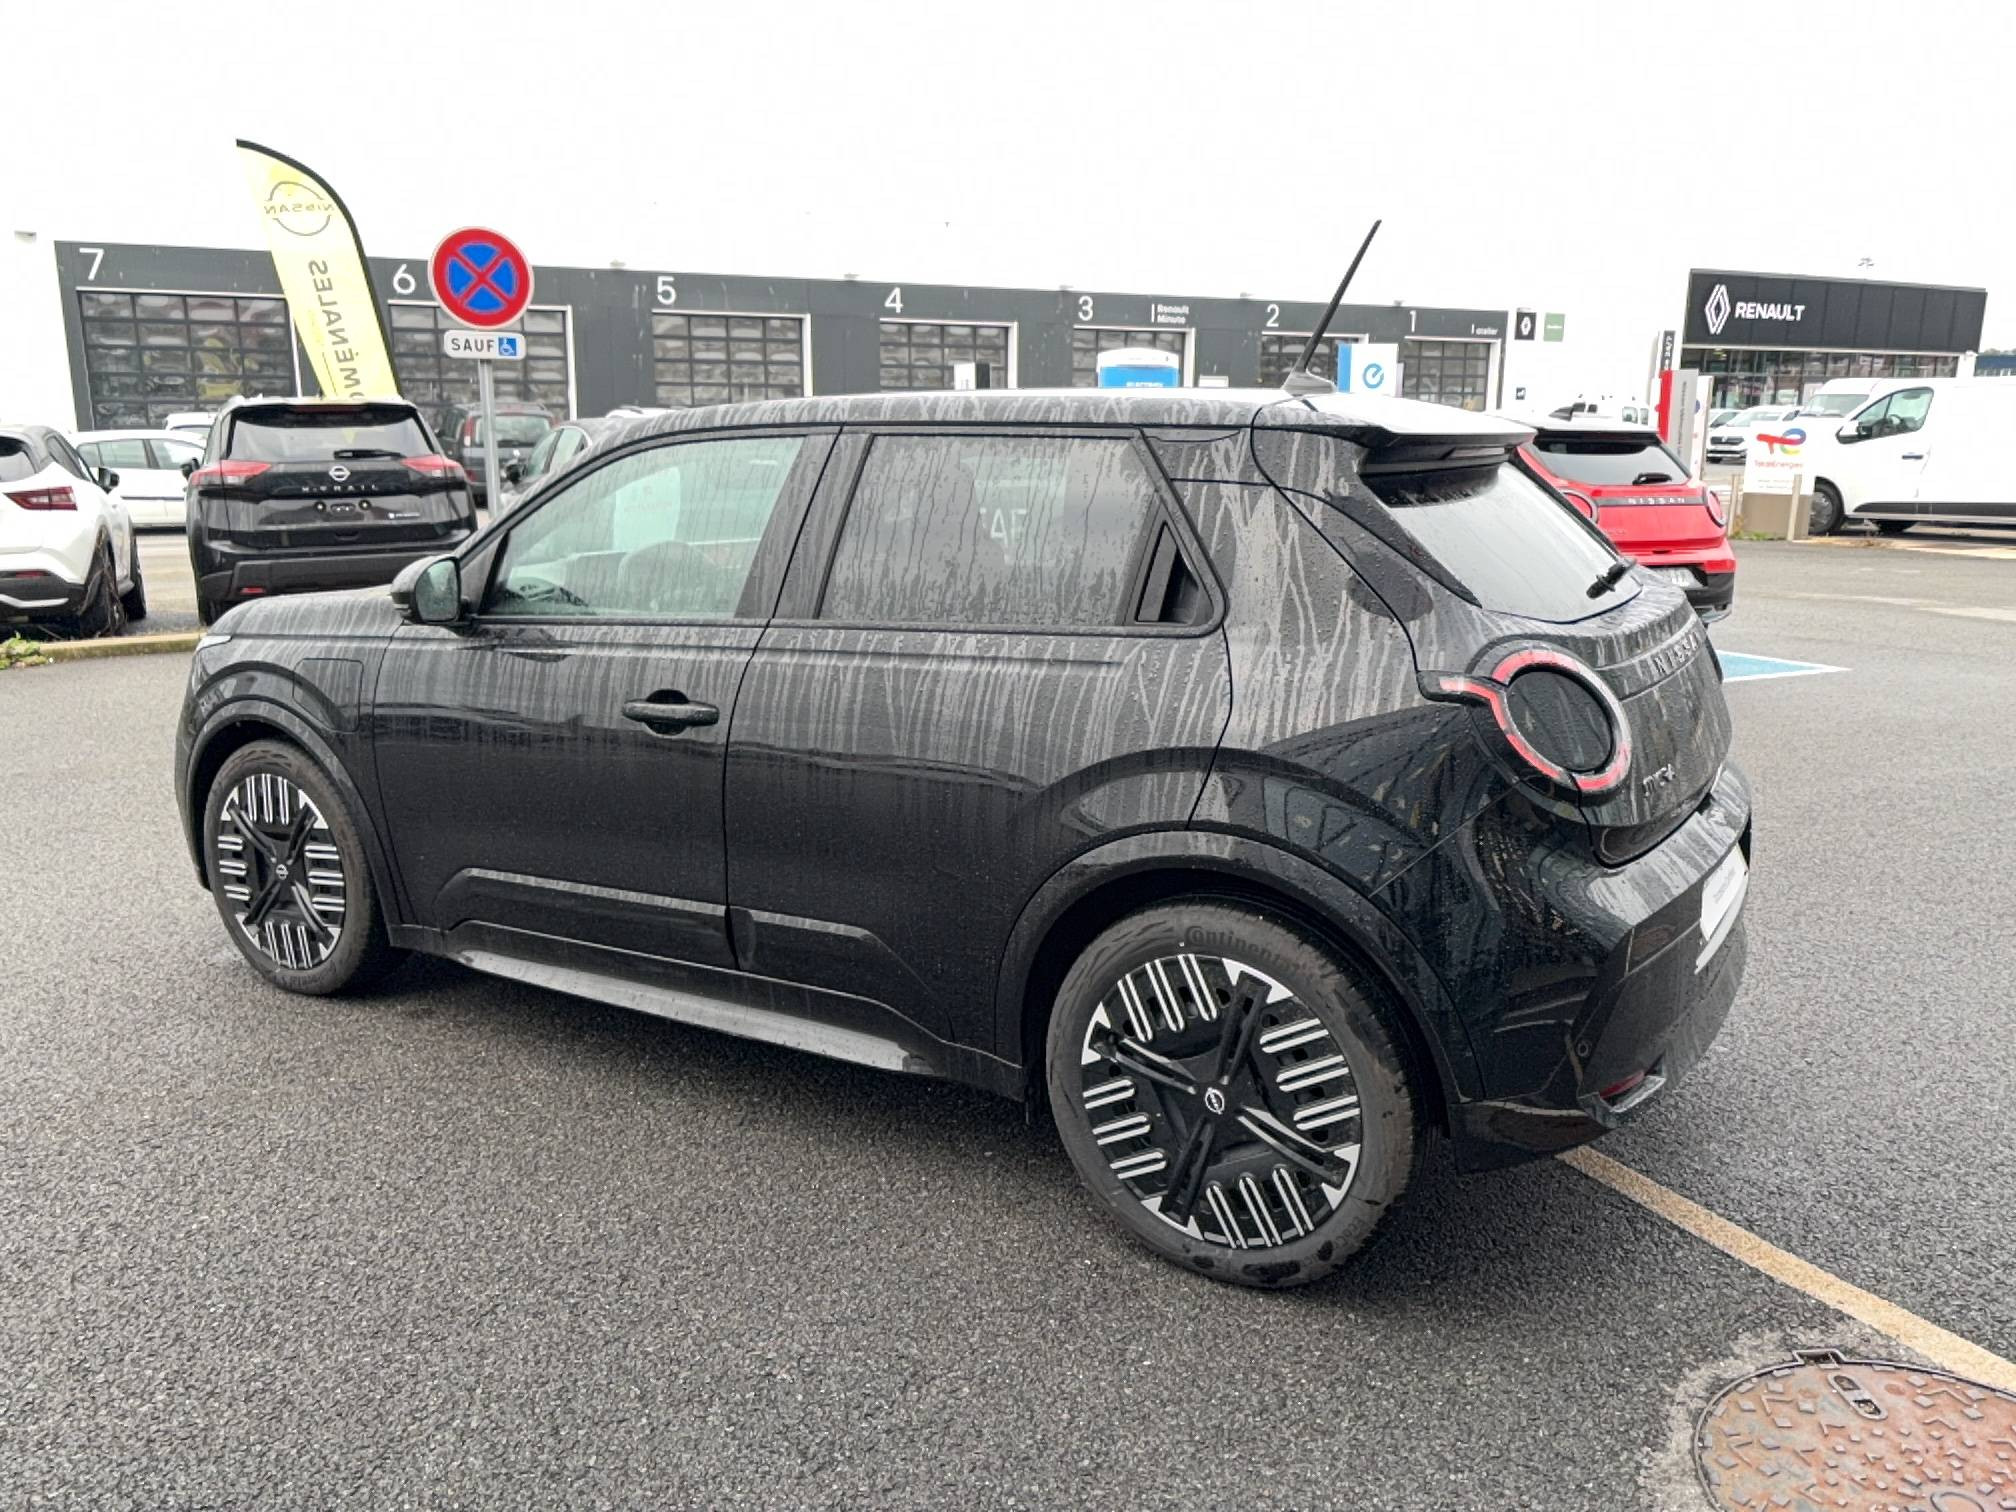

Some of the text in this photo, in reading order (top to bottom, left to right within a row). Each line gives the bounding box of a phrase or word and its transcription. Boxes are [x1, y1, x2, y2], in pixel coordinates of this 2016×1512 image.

[79, 247, 104, 281] 7
[392, 263, 416, 295] 6
[656, 275, 677, 305] 5
[883, 286, 904, 314] 4
[1078, 295, 1094, 321] 3
[1734, 301, 1806, 322] RENAULT
[1265, 303, 1280, 328] 2
[1409, 310, 1417, 333] 1
[451, 337, 496, 353] SAUF
[1627, 497, 1686, 506] NISSAN
